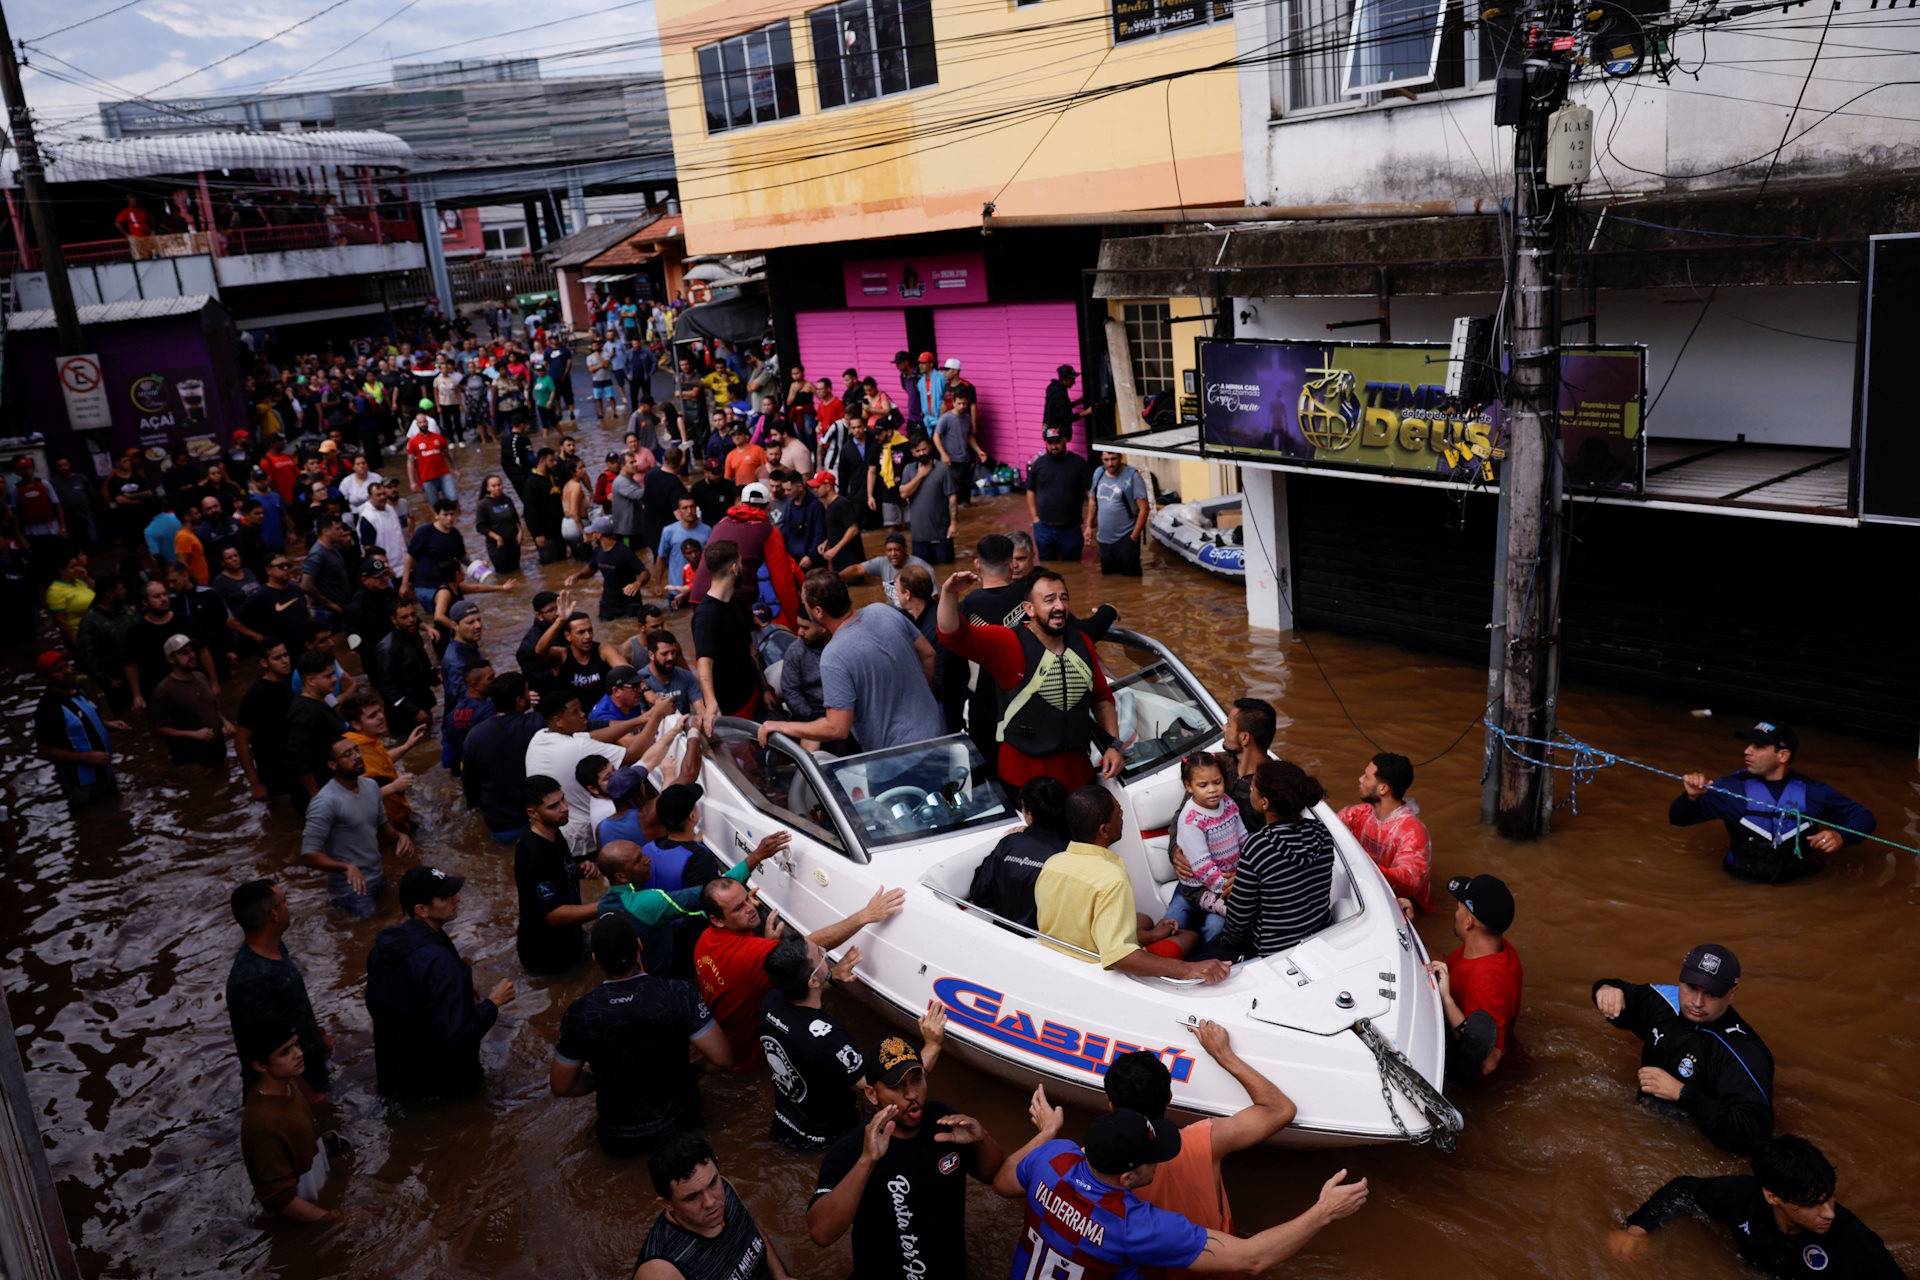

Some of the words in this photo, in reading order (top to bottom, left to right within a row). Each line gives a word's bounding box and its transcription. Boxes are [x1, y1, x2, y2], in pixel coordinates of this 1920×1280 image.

[1570, 140, 1585, 152] 42
[1365, 382, 1447, 410] TEMP
[140, 411, 176, 430] AÇAÍ
[887, 1174, 913, 1231] Basta
[1034, 1181, 1105, 1247] VALDERRAMA
